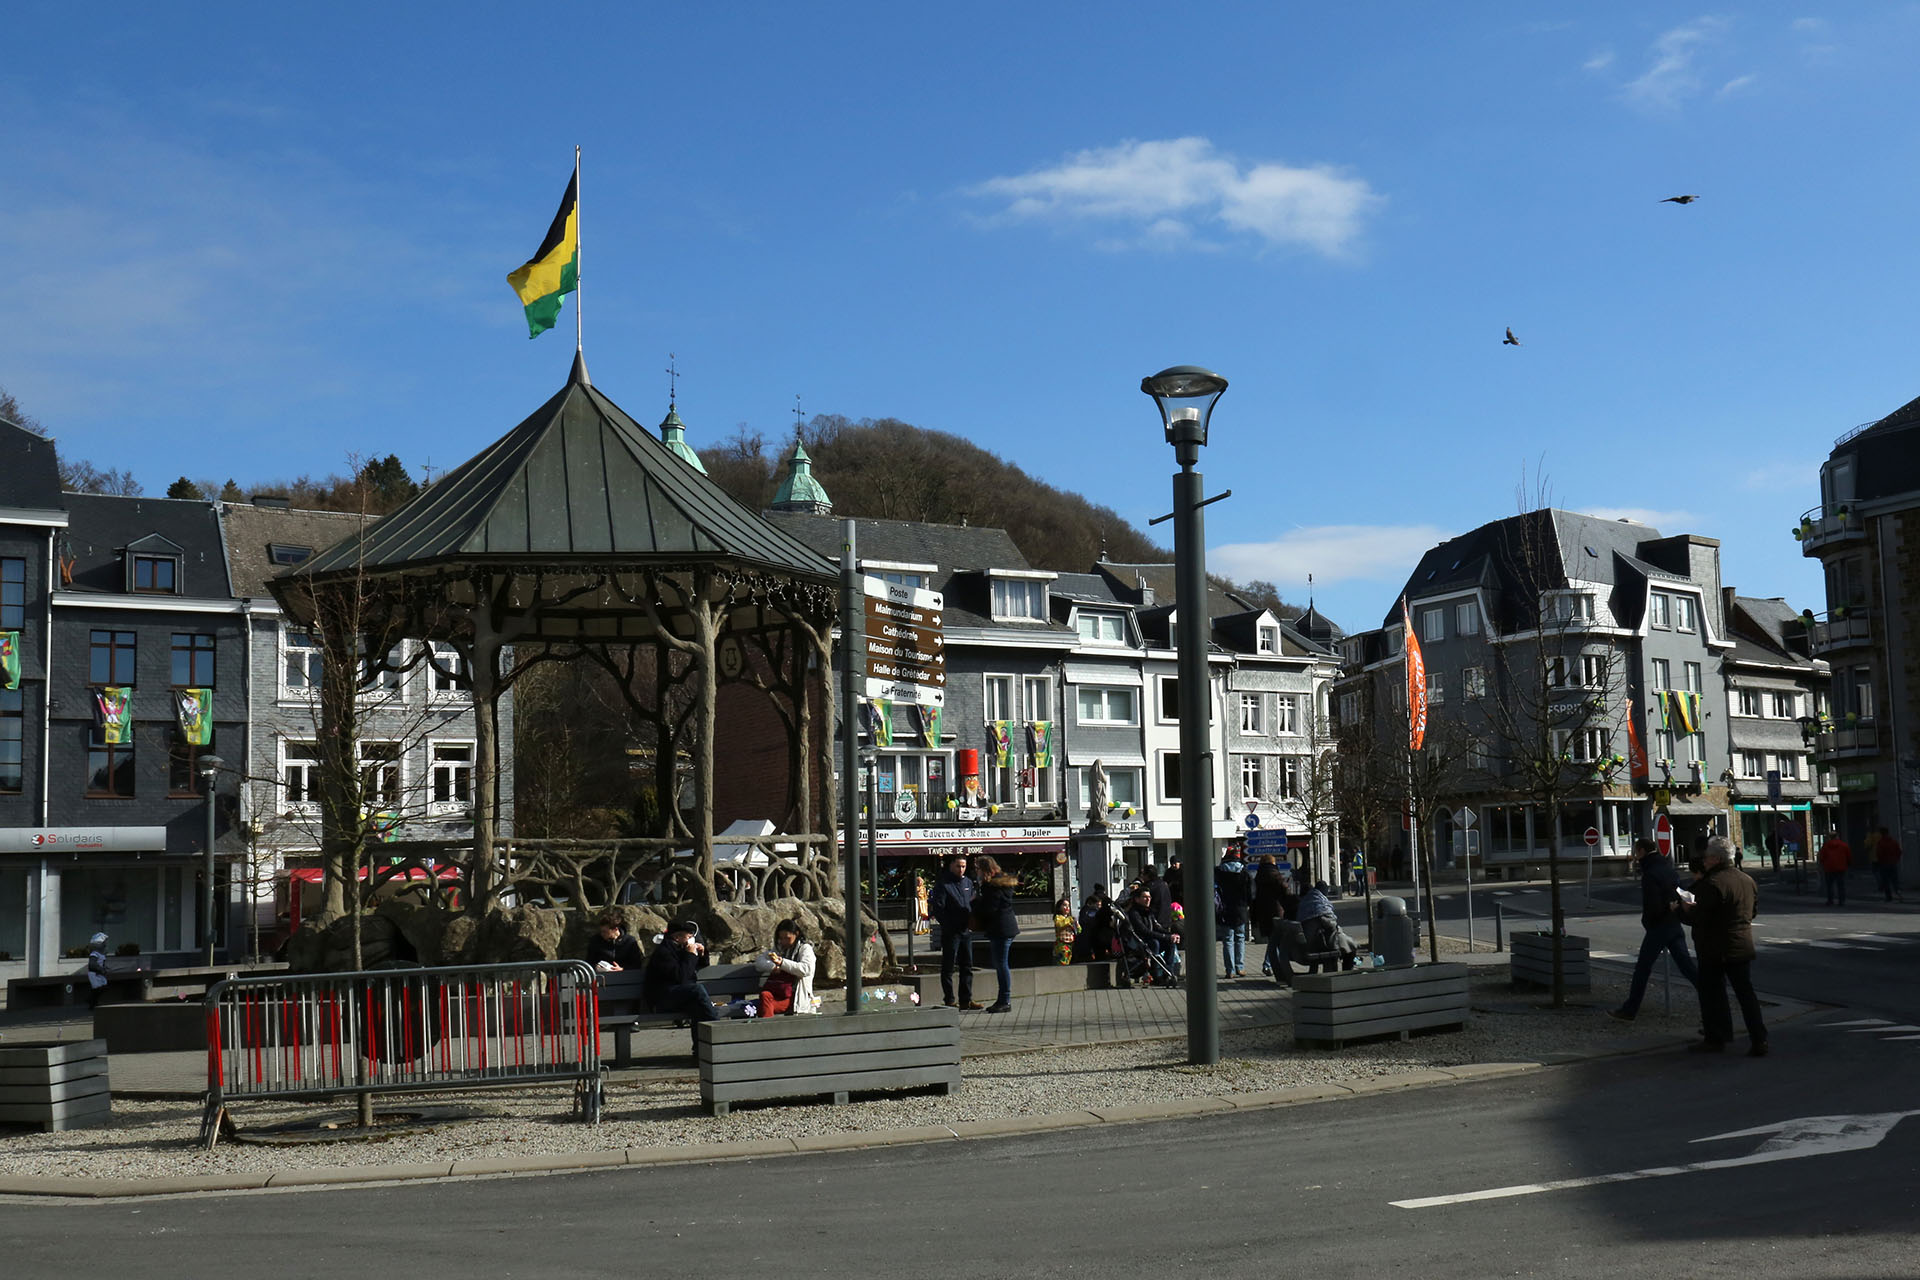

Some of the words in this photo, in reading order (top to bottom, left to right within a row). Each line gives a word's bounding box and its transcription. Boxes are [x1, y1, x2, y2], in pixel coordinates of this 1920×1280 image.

[890, 586, 908, 598] Poste
[875, 603, 922, 622] Malmundarium
[883, 625, 918, 641] Cathédrale
[868, 642, 893, 655] Maison
[894, 647, 903, 657] du
[905, 648, 933, 662] Tourisme
[873, 663, 890, 675] Halle
[891, 665, 900, 677] de
[881, 684, 890, 695] La
[891, 686, 921, 699] Fraternité
[48, 834, 103, 843] Solidaris
[858, 830, 890, 839] Juler
[922, 828, 955, 839] Taverne
[970, 828, 991, 838] Rome
[1022, 828, 1051, 839] Jupiler
[928, 846, 953, 855] TAVERNE
[967, 846, 984, 854] ROME
